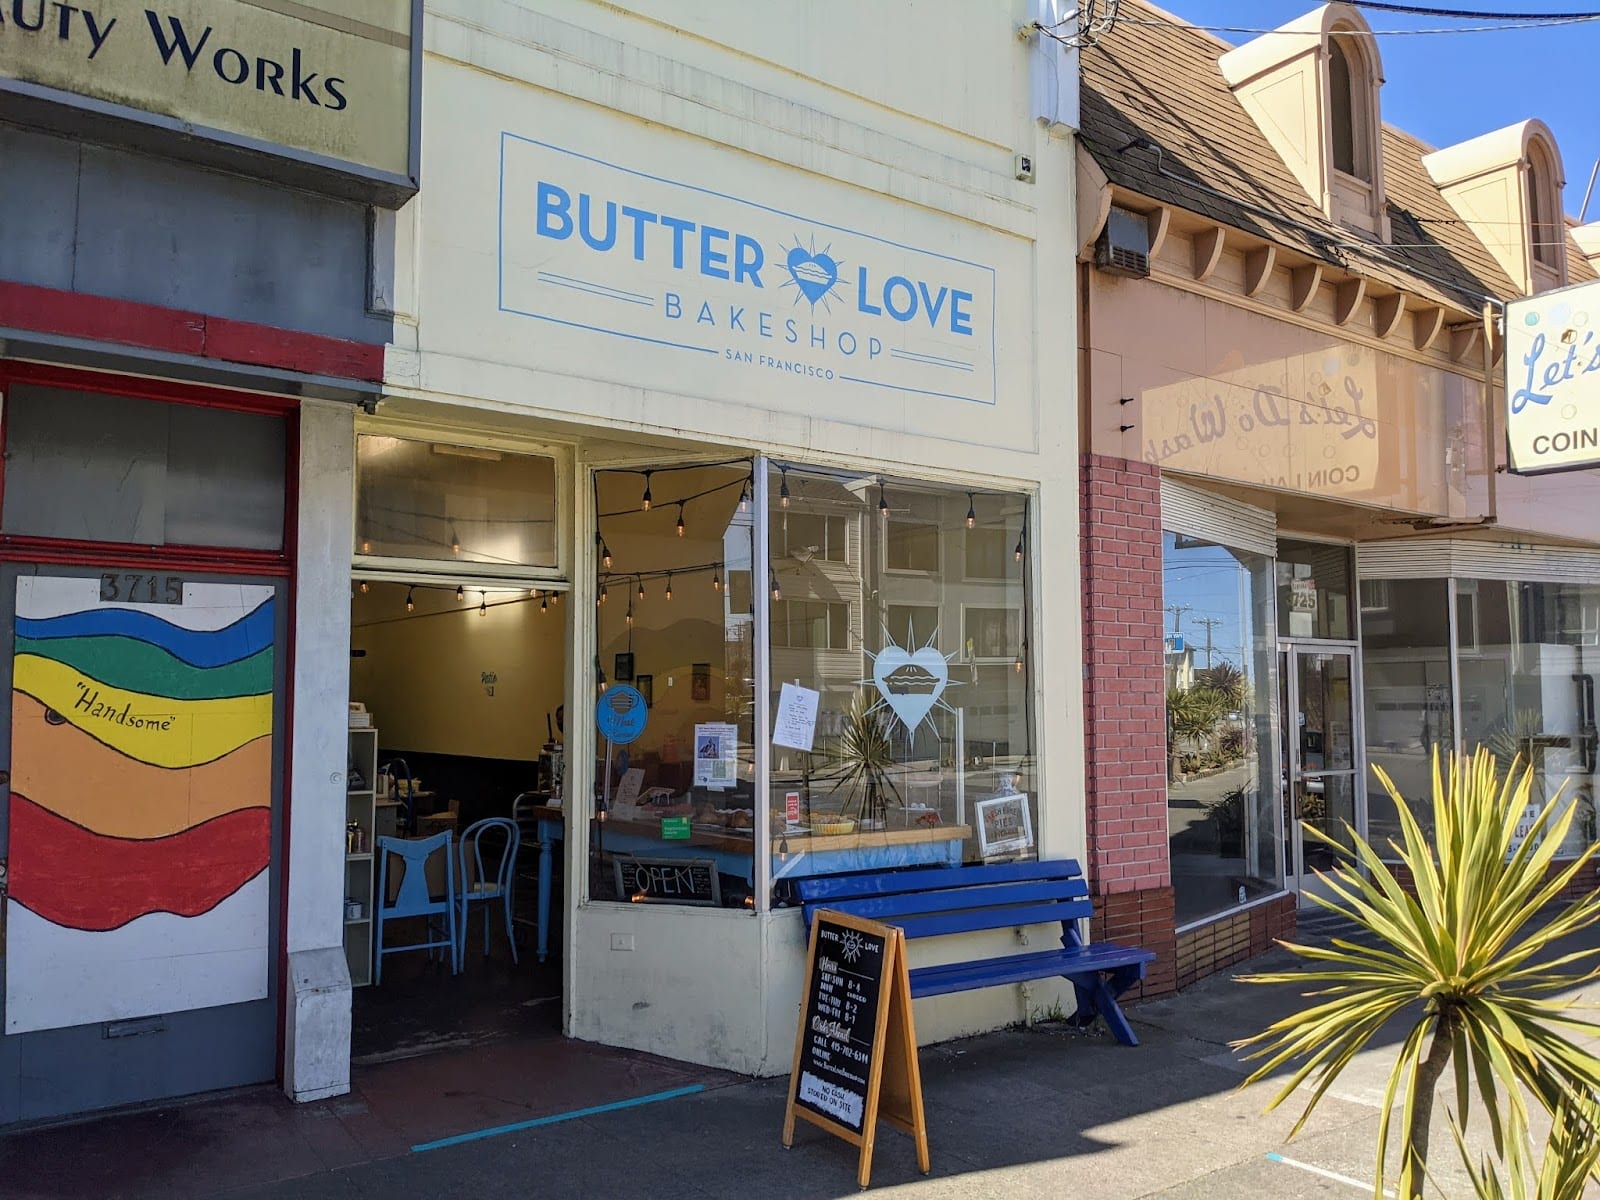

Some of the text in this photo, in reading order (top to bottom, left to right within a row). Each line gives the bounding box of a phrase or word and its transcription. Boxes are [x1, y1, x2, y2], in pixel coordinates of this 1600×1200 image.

[536, 181, 973, 336] BUTTER LOVE
[665, 292, 883, 358] BAKESHOP
[725, 348, 835, 381] SAN FRANCISCO
[1532, 427, 1598, 455] COIN
[100, 573, 182, 604] 3715
[635, 866, 696, 895] OPEN
[820, 929, 879, 954] BUTTER LOVE
[822, 1085, 831, 1096] NO
[829, 1097, 838, 1107] ON
[839, 1100, 852, 1115] SITE
